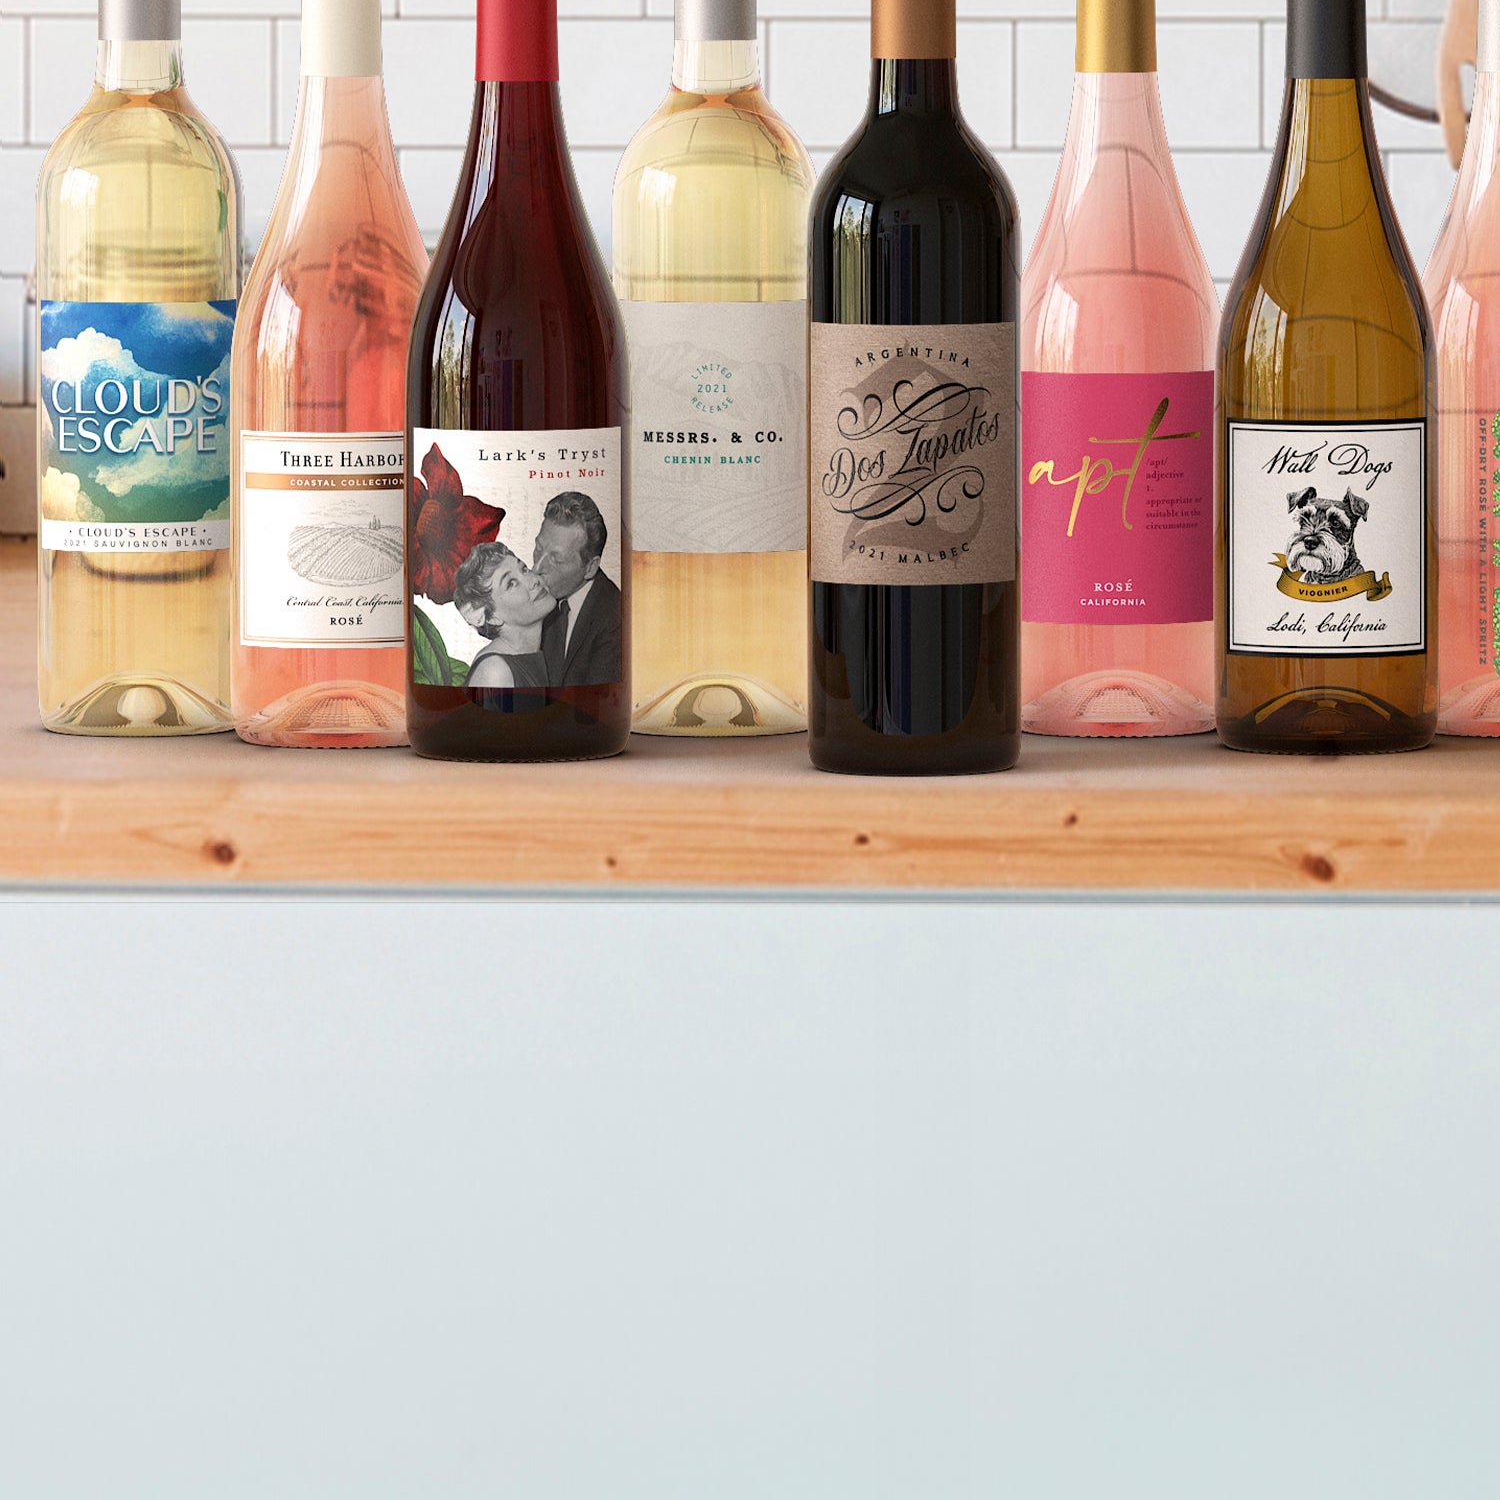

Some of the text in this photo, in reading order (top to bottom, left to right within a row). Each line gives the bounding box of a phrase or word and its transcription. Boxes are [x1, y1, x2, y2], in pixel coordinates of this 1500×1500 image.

[855, 347, 970, 368] ARGENTINA
[691, 363, 732, 380] LIMITED
[52, 375, 222, 415] CLOUD'S
[697, 384, 728, 393] 2021
[690, 396, 734, 414] RELEASE
[58, 416, 217, 454] ESCAPE
[643, 431, 783, 444] MESSRS. & CO.
[821, 405, 1000, 499] Dos Zapatos
[1479, 418, 1487, 473] OFF-DRY
[280, 451, 334, 468] THREE
[478, 447, 606, 463] Lark's Tryst
[664, 455, 761, 465] CHENIN BLANC
[528, 468, 606, 479] Pinot Noir
[1028, 396, 1201, 537] apt
[1261, 440, 1393, 491] Wall Dogs
[289, 479, 336, 487] COASTAL
[1146, 470, 1184, 481] adjective
[78, 526, 198, 538] CLOUD'S ESCAPE
[1479, 517, 1487, 553] WITH
[63, 538, 213, 548] 2021 SAUVIGNON BLANC
[849, 539, 971, 564] 2021 MALBEC
[1479, 559, 1487, 567] A
[1094, 579, 1134, 592] ROSÉ
[1298, 585, 1349, 597] VIOGNIER
[1479, 572, 1487, 613] LIGHT
[286, 595, 325, 607] Central
[1080, 597, 1147, 606] CALIFORNIA
[330, 613, 363, 626] ROSÉ
[1266, 611, 1389, 642] Lodi, California
[1479, 618, 1487, 665] SPRITZ
